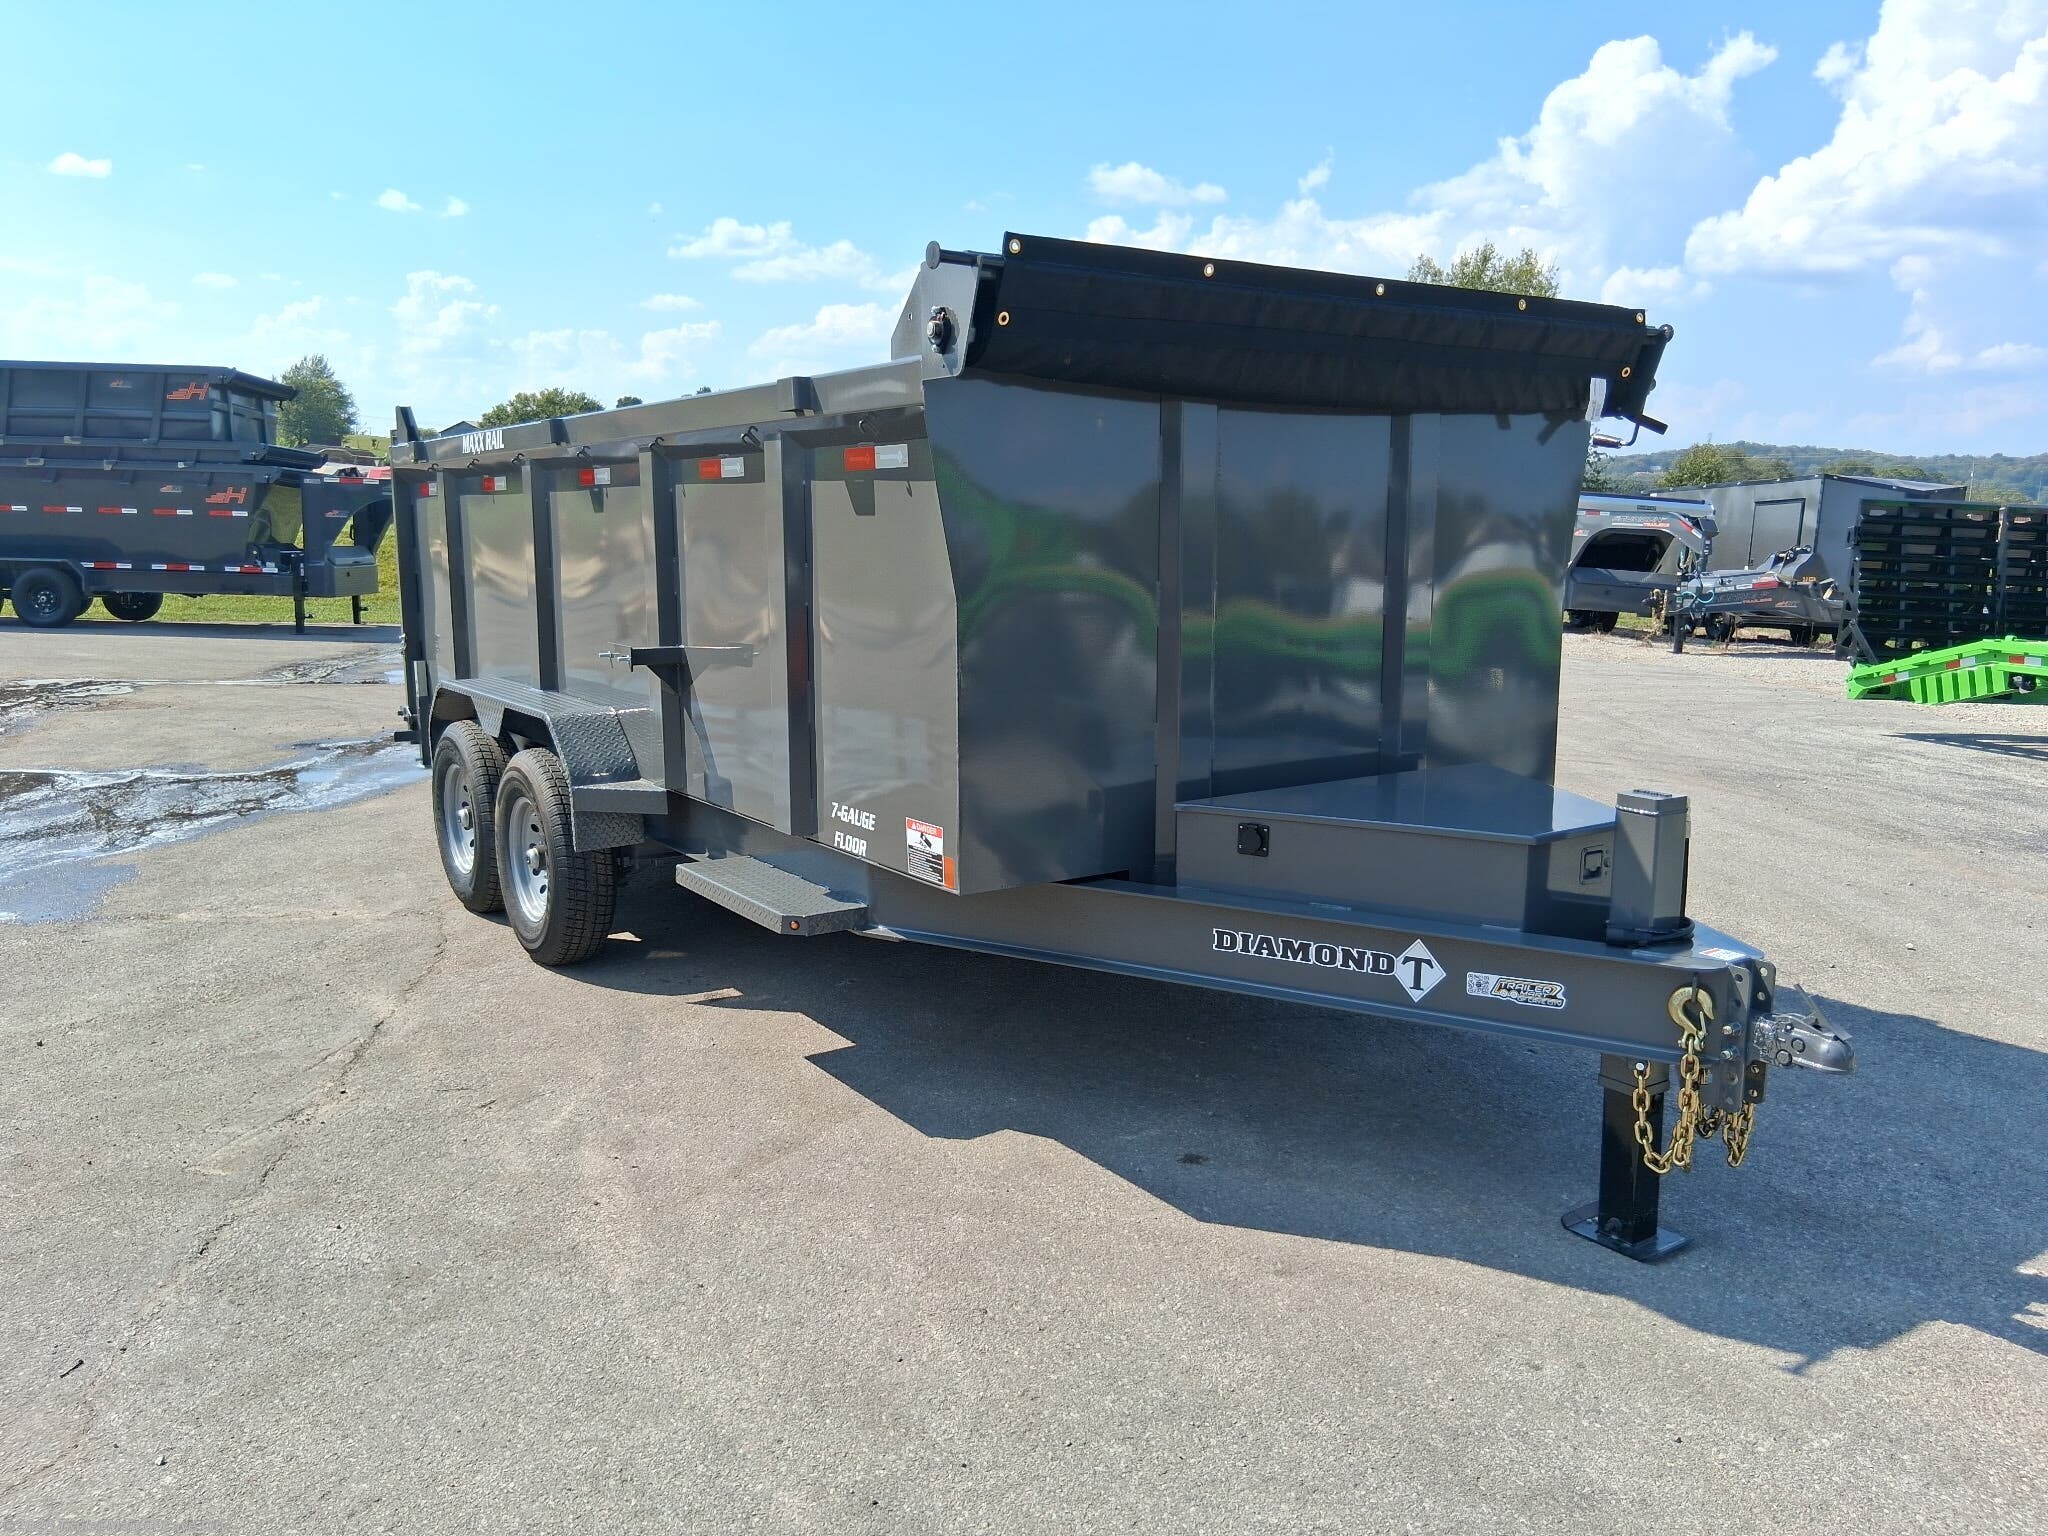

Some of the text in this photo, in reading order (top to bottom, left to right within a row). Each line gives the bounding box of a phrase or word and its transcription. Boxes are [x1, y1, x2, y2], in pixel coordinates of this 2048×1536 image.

[462, 429, 505, 455] MAXX RAIL
[831, 801, 877, 831] 7-GAUGE
[833, 830, 868, 857] FLOOR
[1212, 928, 1435, 991] DIAMOND T
[1499, 981, 1552, 993] TRAILER
